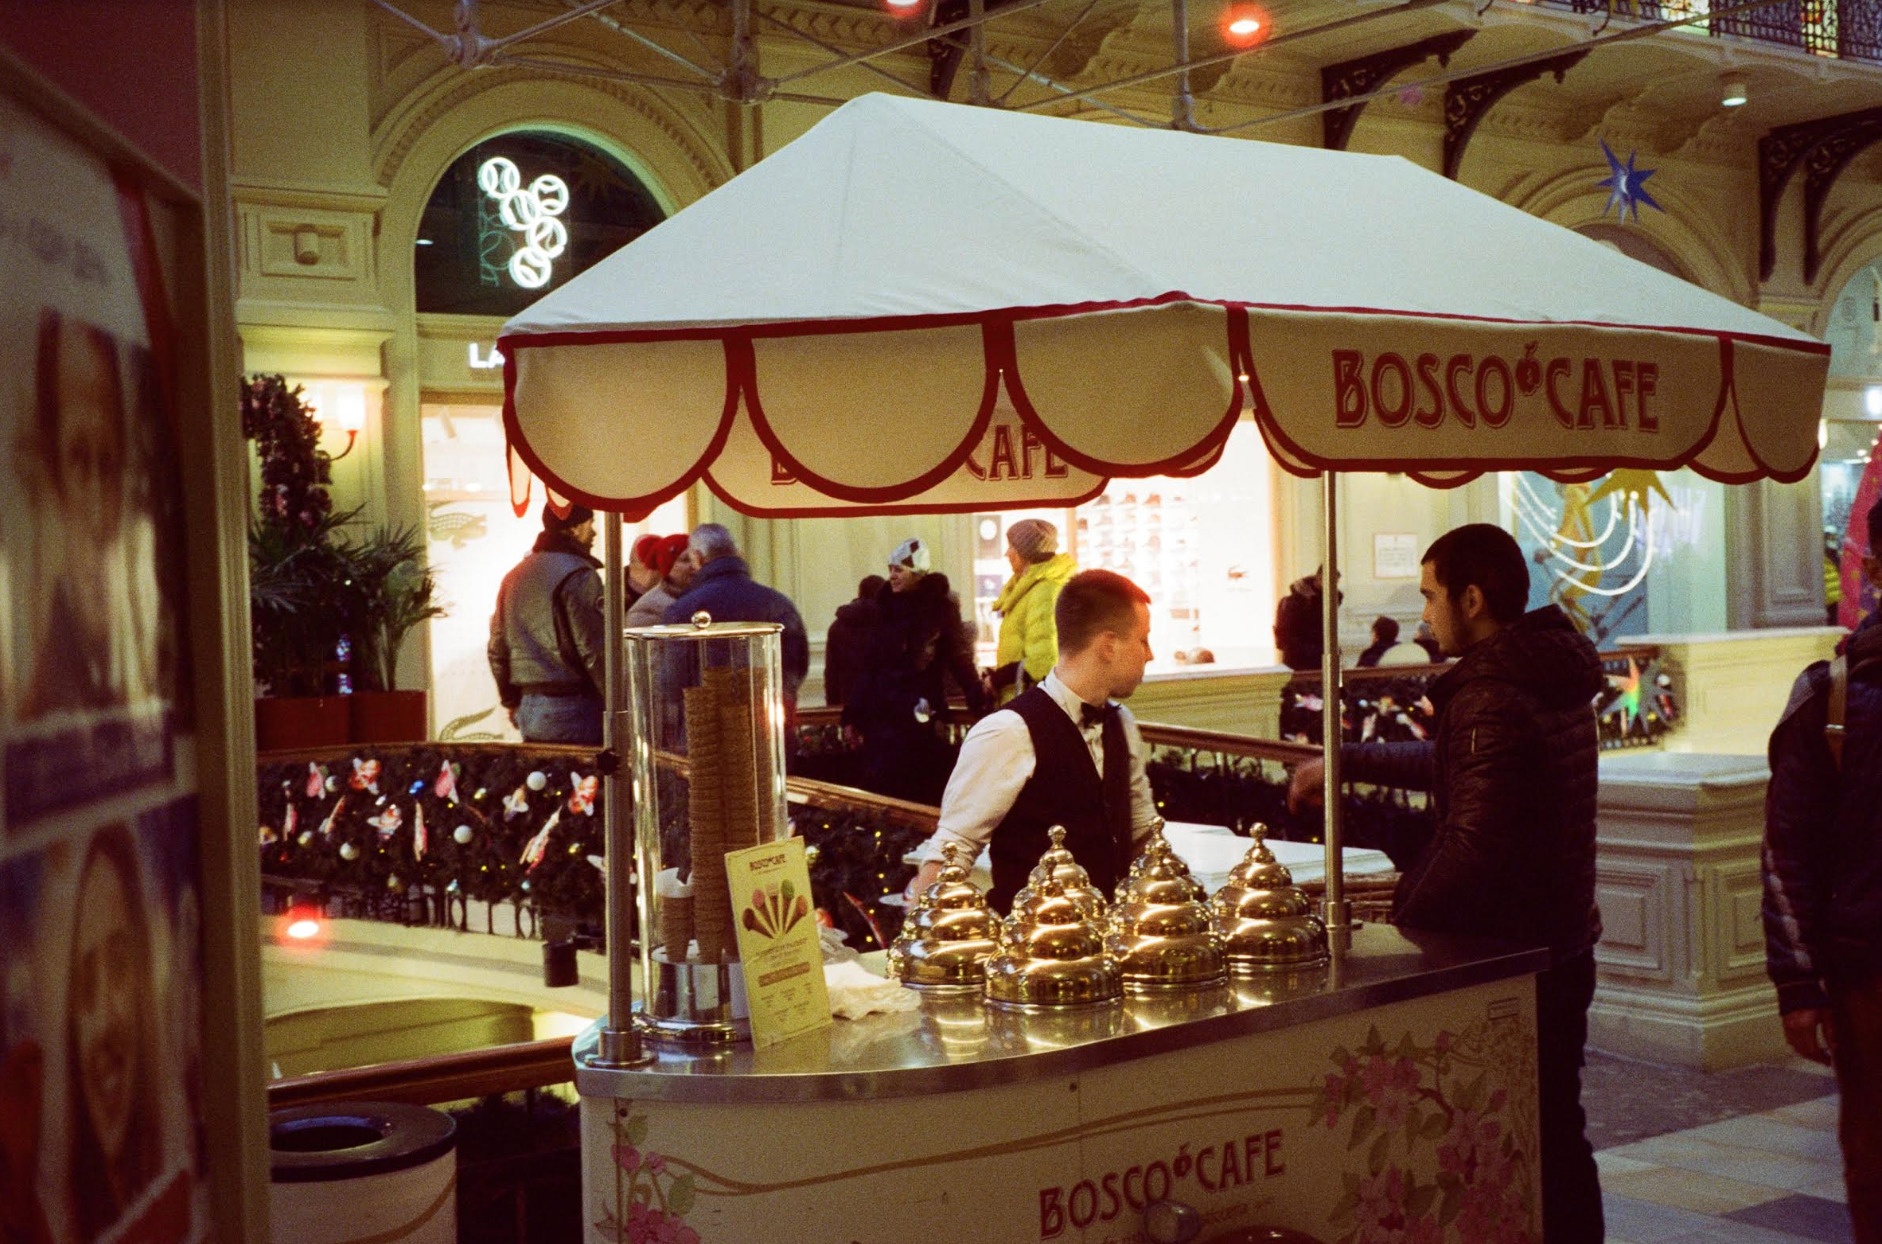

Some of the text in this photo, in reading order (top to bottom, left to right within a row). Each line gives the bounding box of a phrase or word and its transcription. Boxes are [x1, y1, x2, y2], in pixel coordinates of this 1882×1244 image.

[1332, 349, 1660, 433] BOSCO CAFE
[1038, 1160, 1172, 1241] BOSCO
[1195, 1128, 1286, 1194] CAFE
